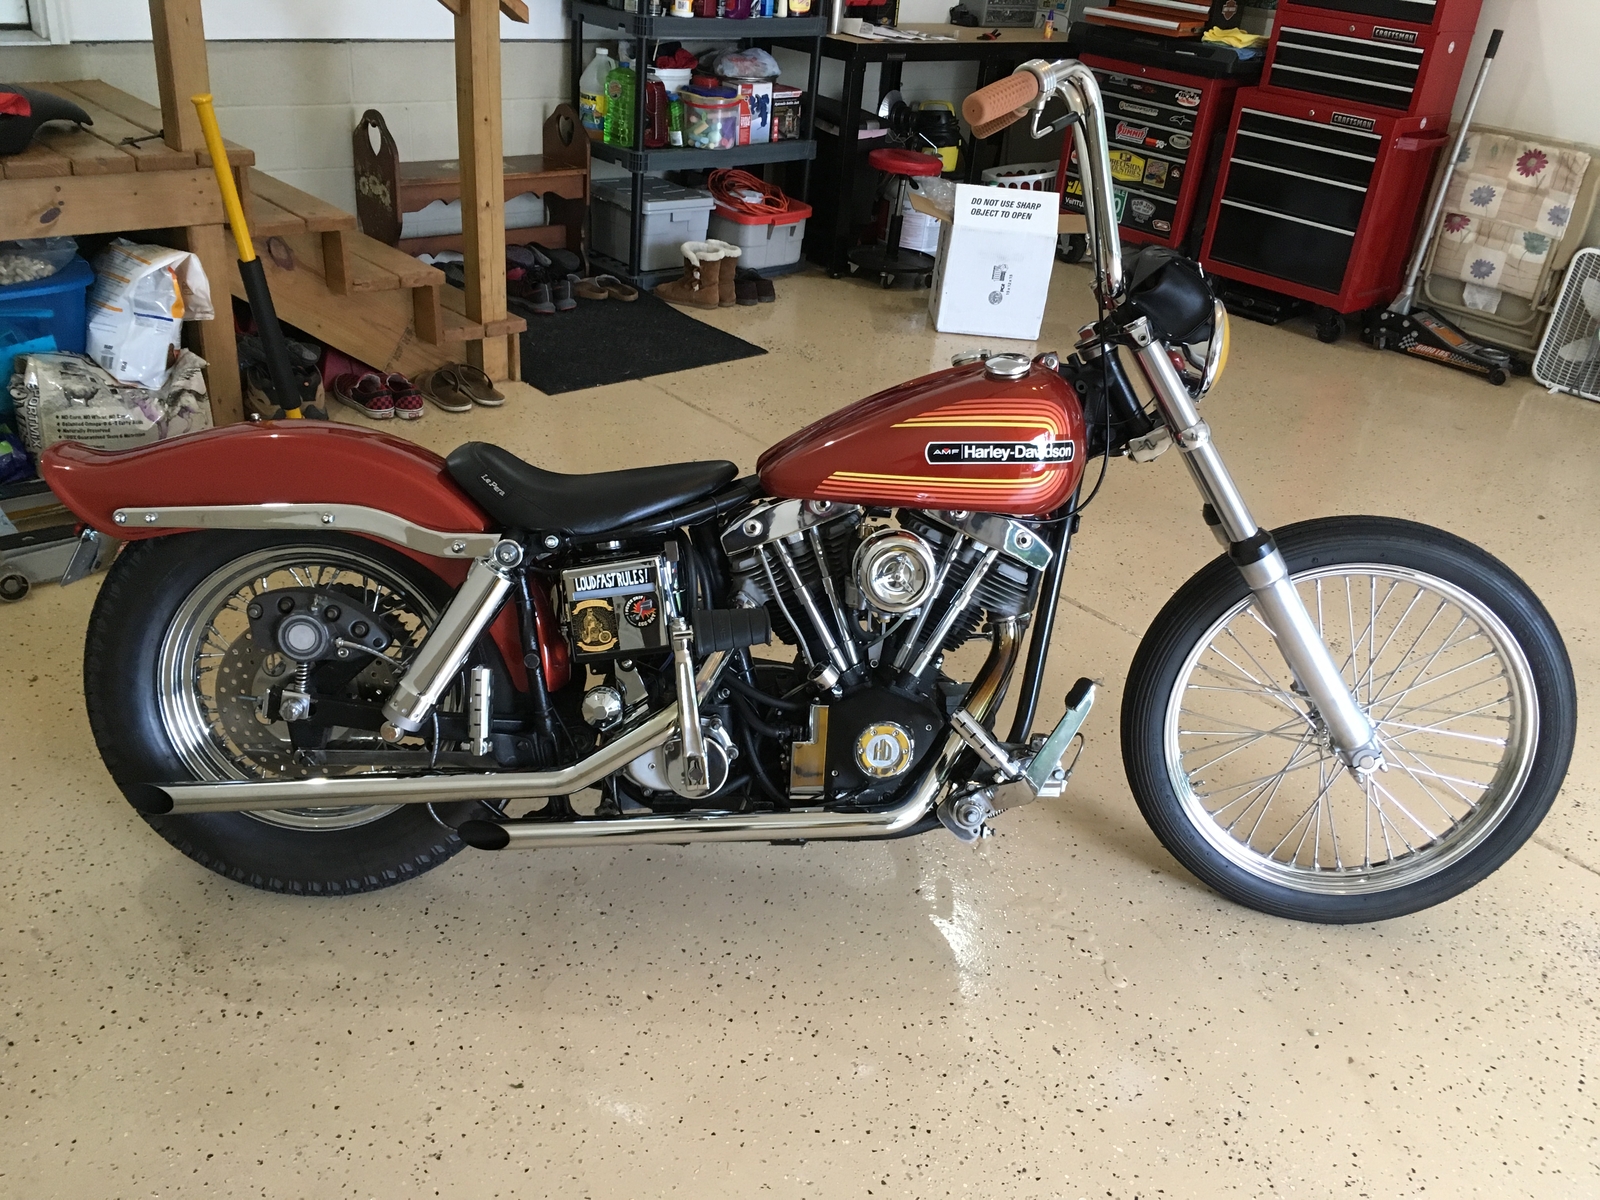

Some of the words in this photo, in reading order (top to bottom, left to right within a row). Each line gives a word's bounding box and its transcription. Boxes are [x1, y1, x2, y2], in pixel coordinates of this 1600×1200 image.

[1375, 29, 1414, 42] CRAFTSMAN
[1333, 114, 1372, 129] CRAFTSMAN
[1117, 122, 1145, 139] SUMMIT
[970, 197, 983, 206] DO
[983, 198, 999, 207] NOT
[1000, 199, 1014, 209] USE
[1016, 201, 1042, 210] SHARP
[970, 208, 999, 218] OBJECT
[1000, 210, 1010, 218] TO
[1011, 211, 1032, 220] OPEN
[1435, 348, 1451, 358] LBS
[932, 447, 960, 456] AMF
[964, 444, 1072, 461] Harley-Davdson
[480, 473, 491, 484] Le
[489, 481, 506, 497] Pera
[574, 576, 596, 592] LOUD
[596, 572, 617, 589] FAST
[616, 568, 648, 587] RULES!
